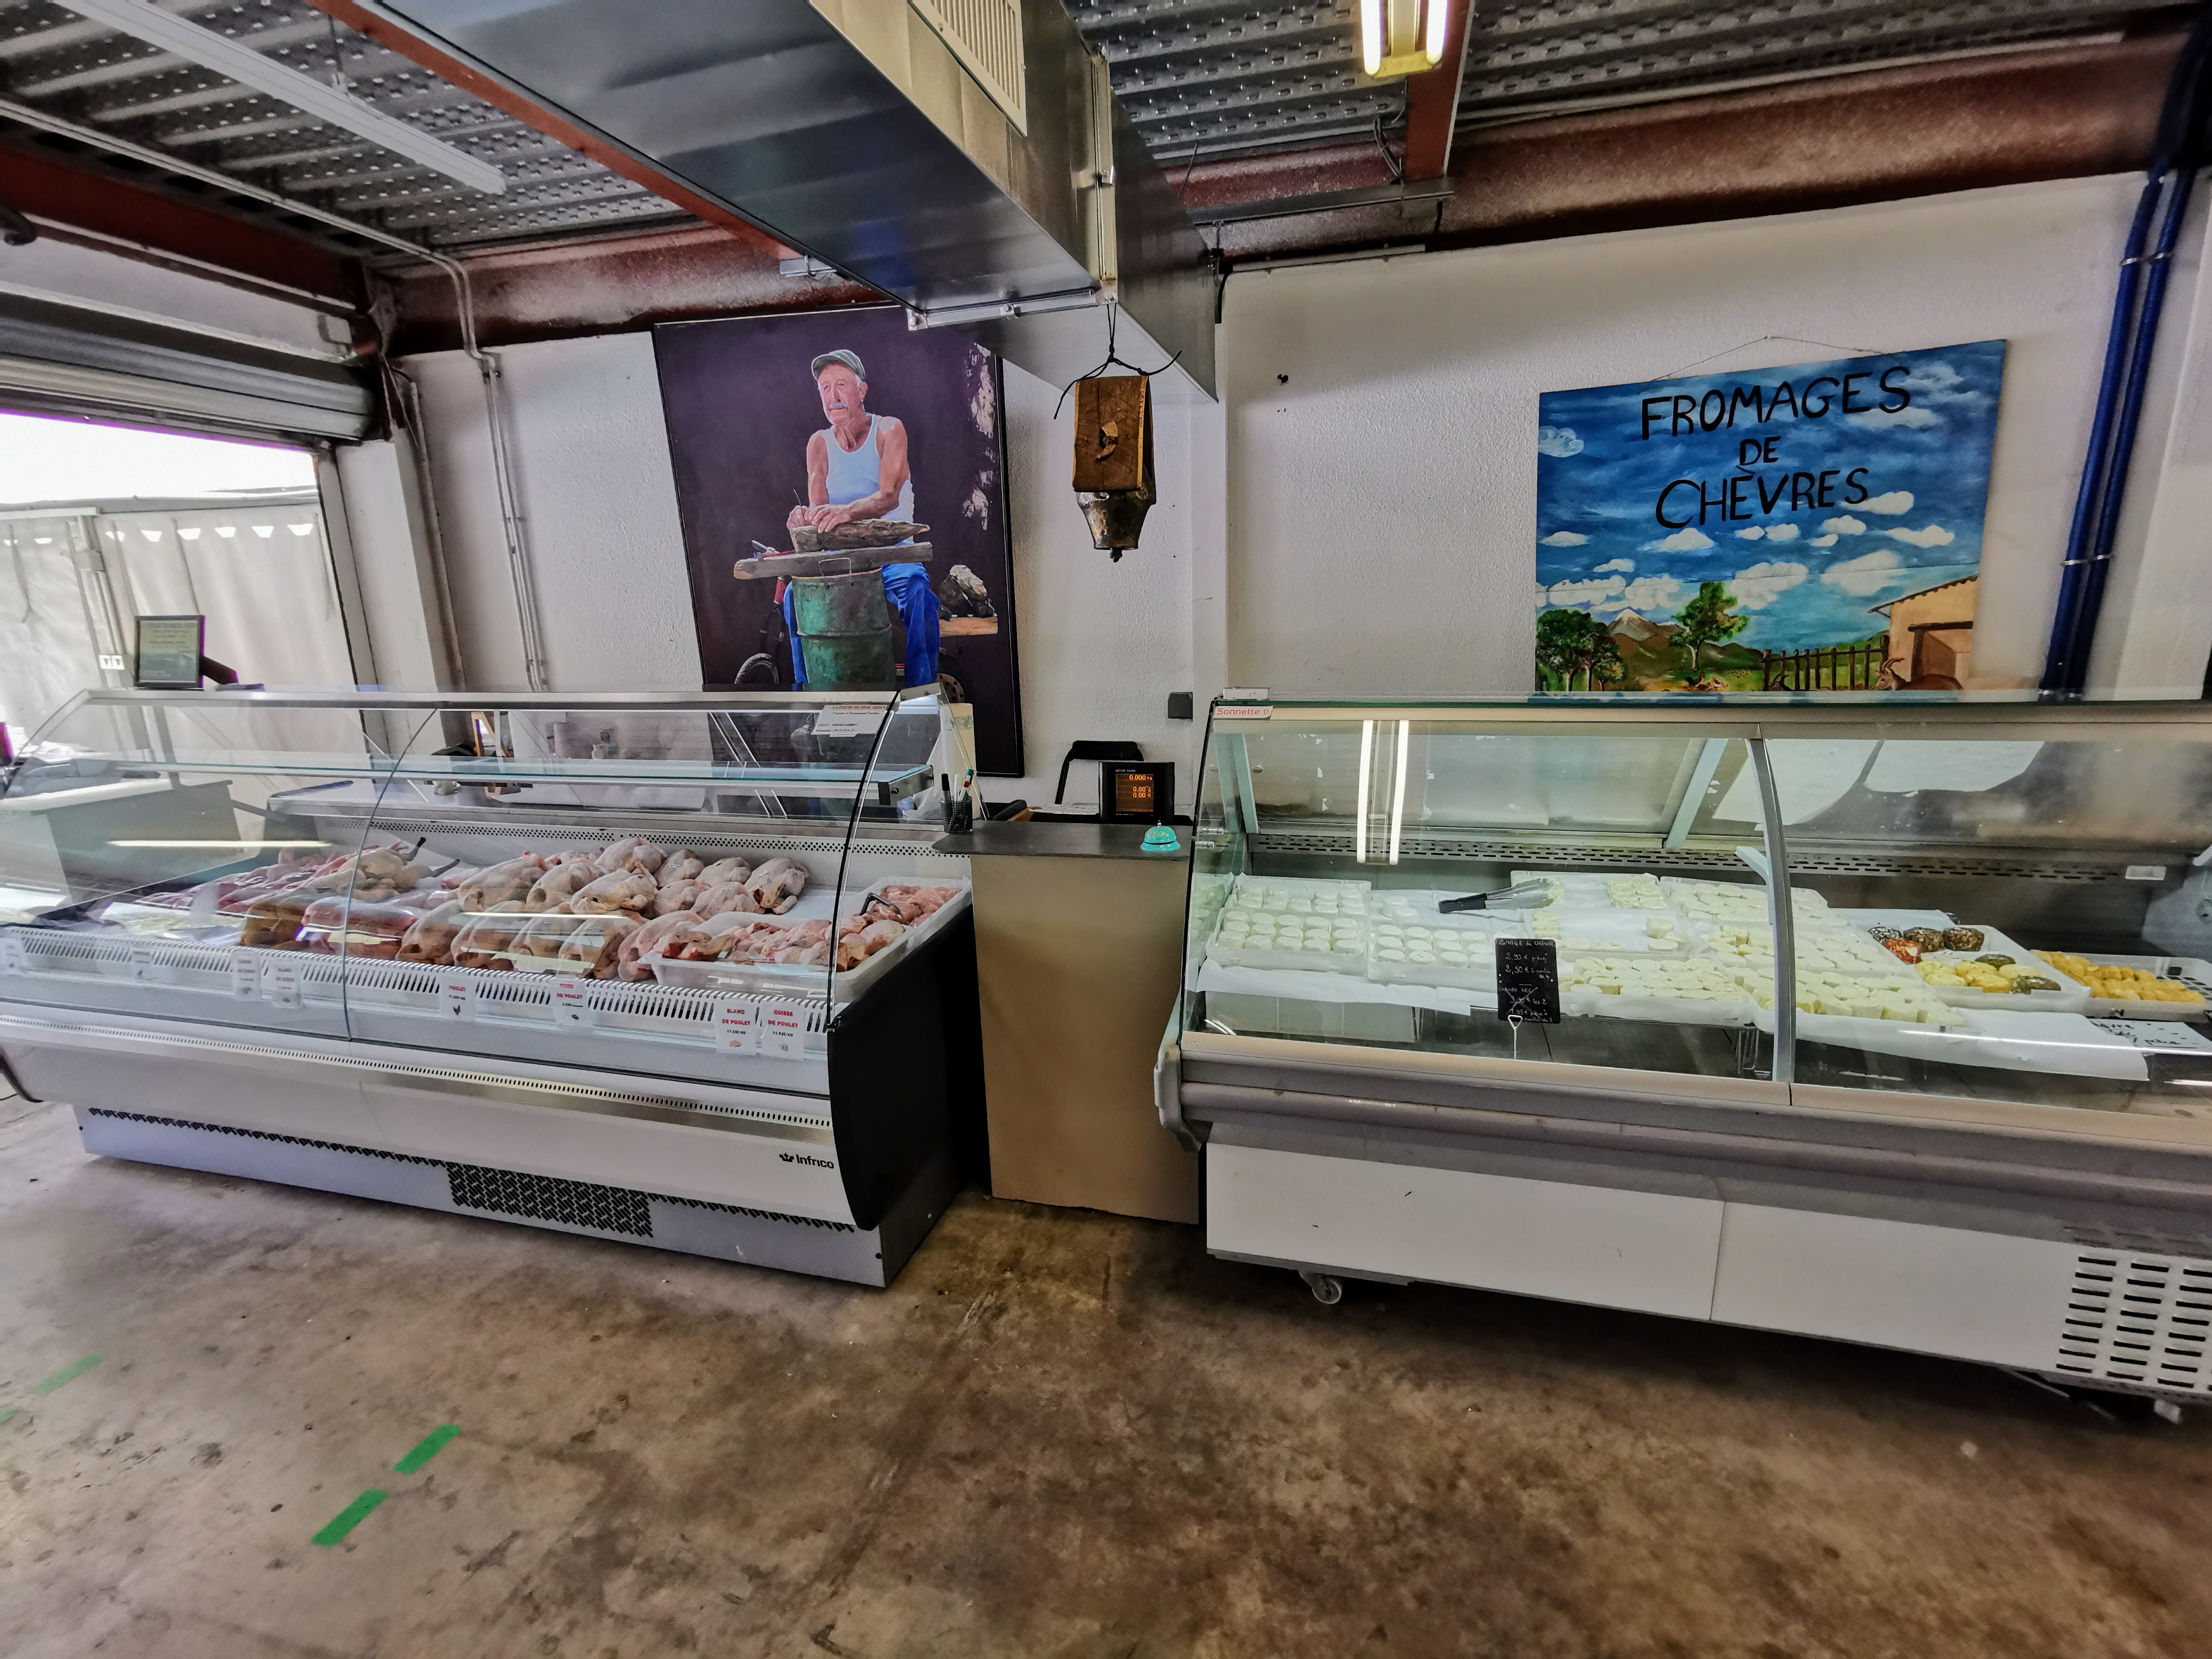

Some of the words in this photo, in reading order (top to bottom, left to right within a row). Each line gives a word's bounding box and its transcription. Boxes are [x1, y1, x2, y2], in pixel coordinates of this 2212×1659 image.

[1641, 366, 1910, 440] FROMAGES
[1739, 436, 1780, 465] DE
[1656, 466, 1869, 528] CHÈVRES
